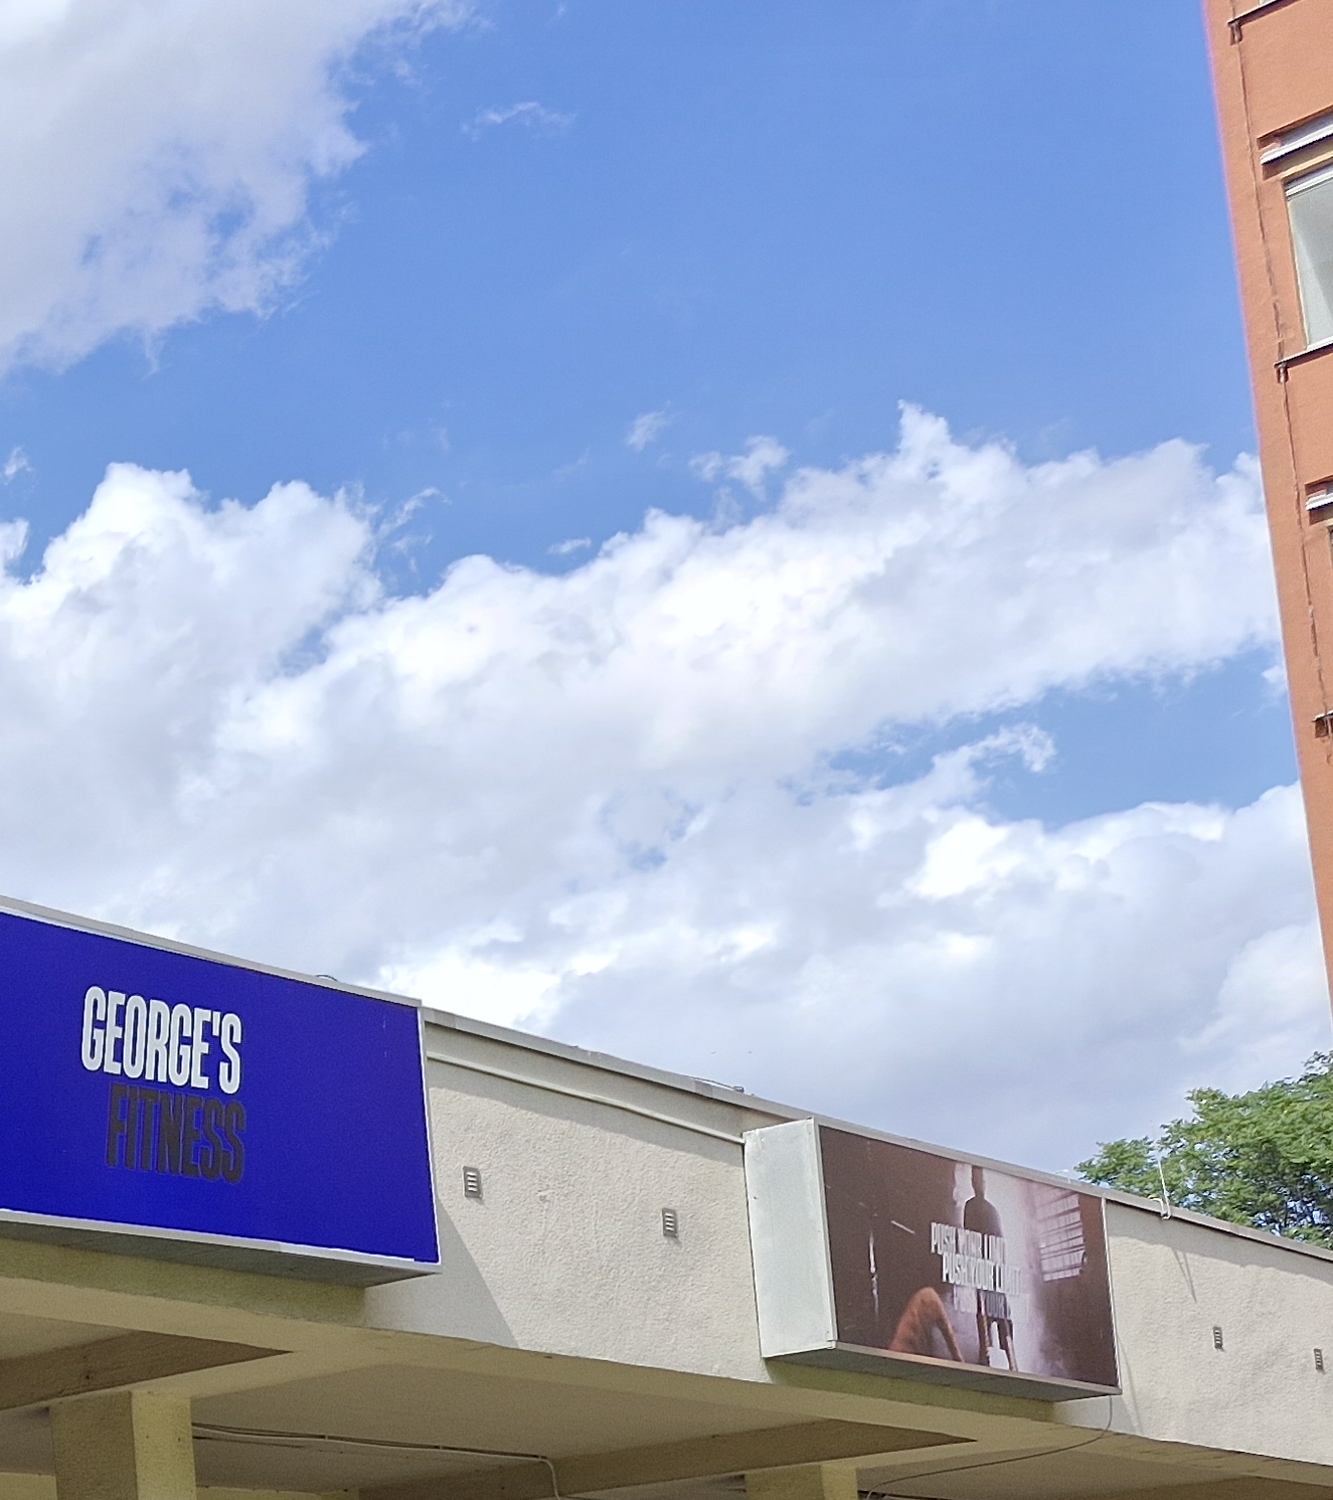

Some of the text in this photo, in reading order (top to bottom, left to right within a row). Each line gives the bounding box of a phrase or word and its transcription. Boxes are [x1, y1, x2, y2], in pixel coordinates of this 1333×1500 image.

[81, 986, 242, 1094] GEORGE'S
[106, 1083, 246, 1185] FITNESS
[930, 1222, 956, 1255] PUSH
[942, 1252, 1021, 1295] PUSH YOUR LIMIT
